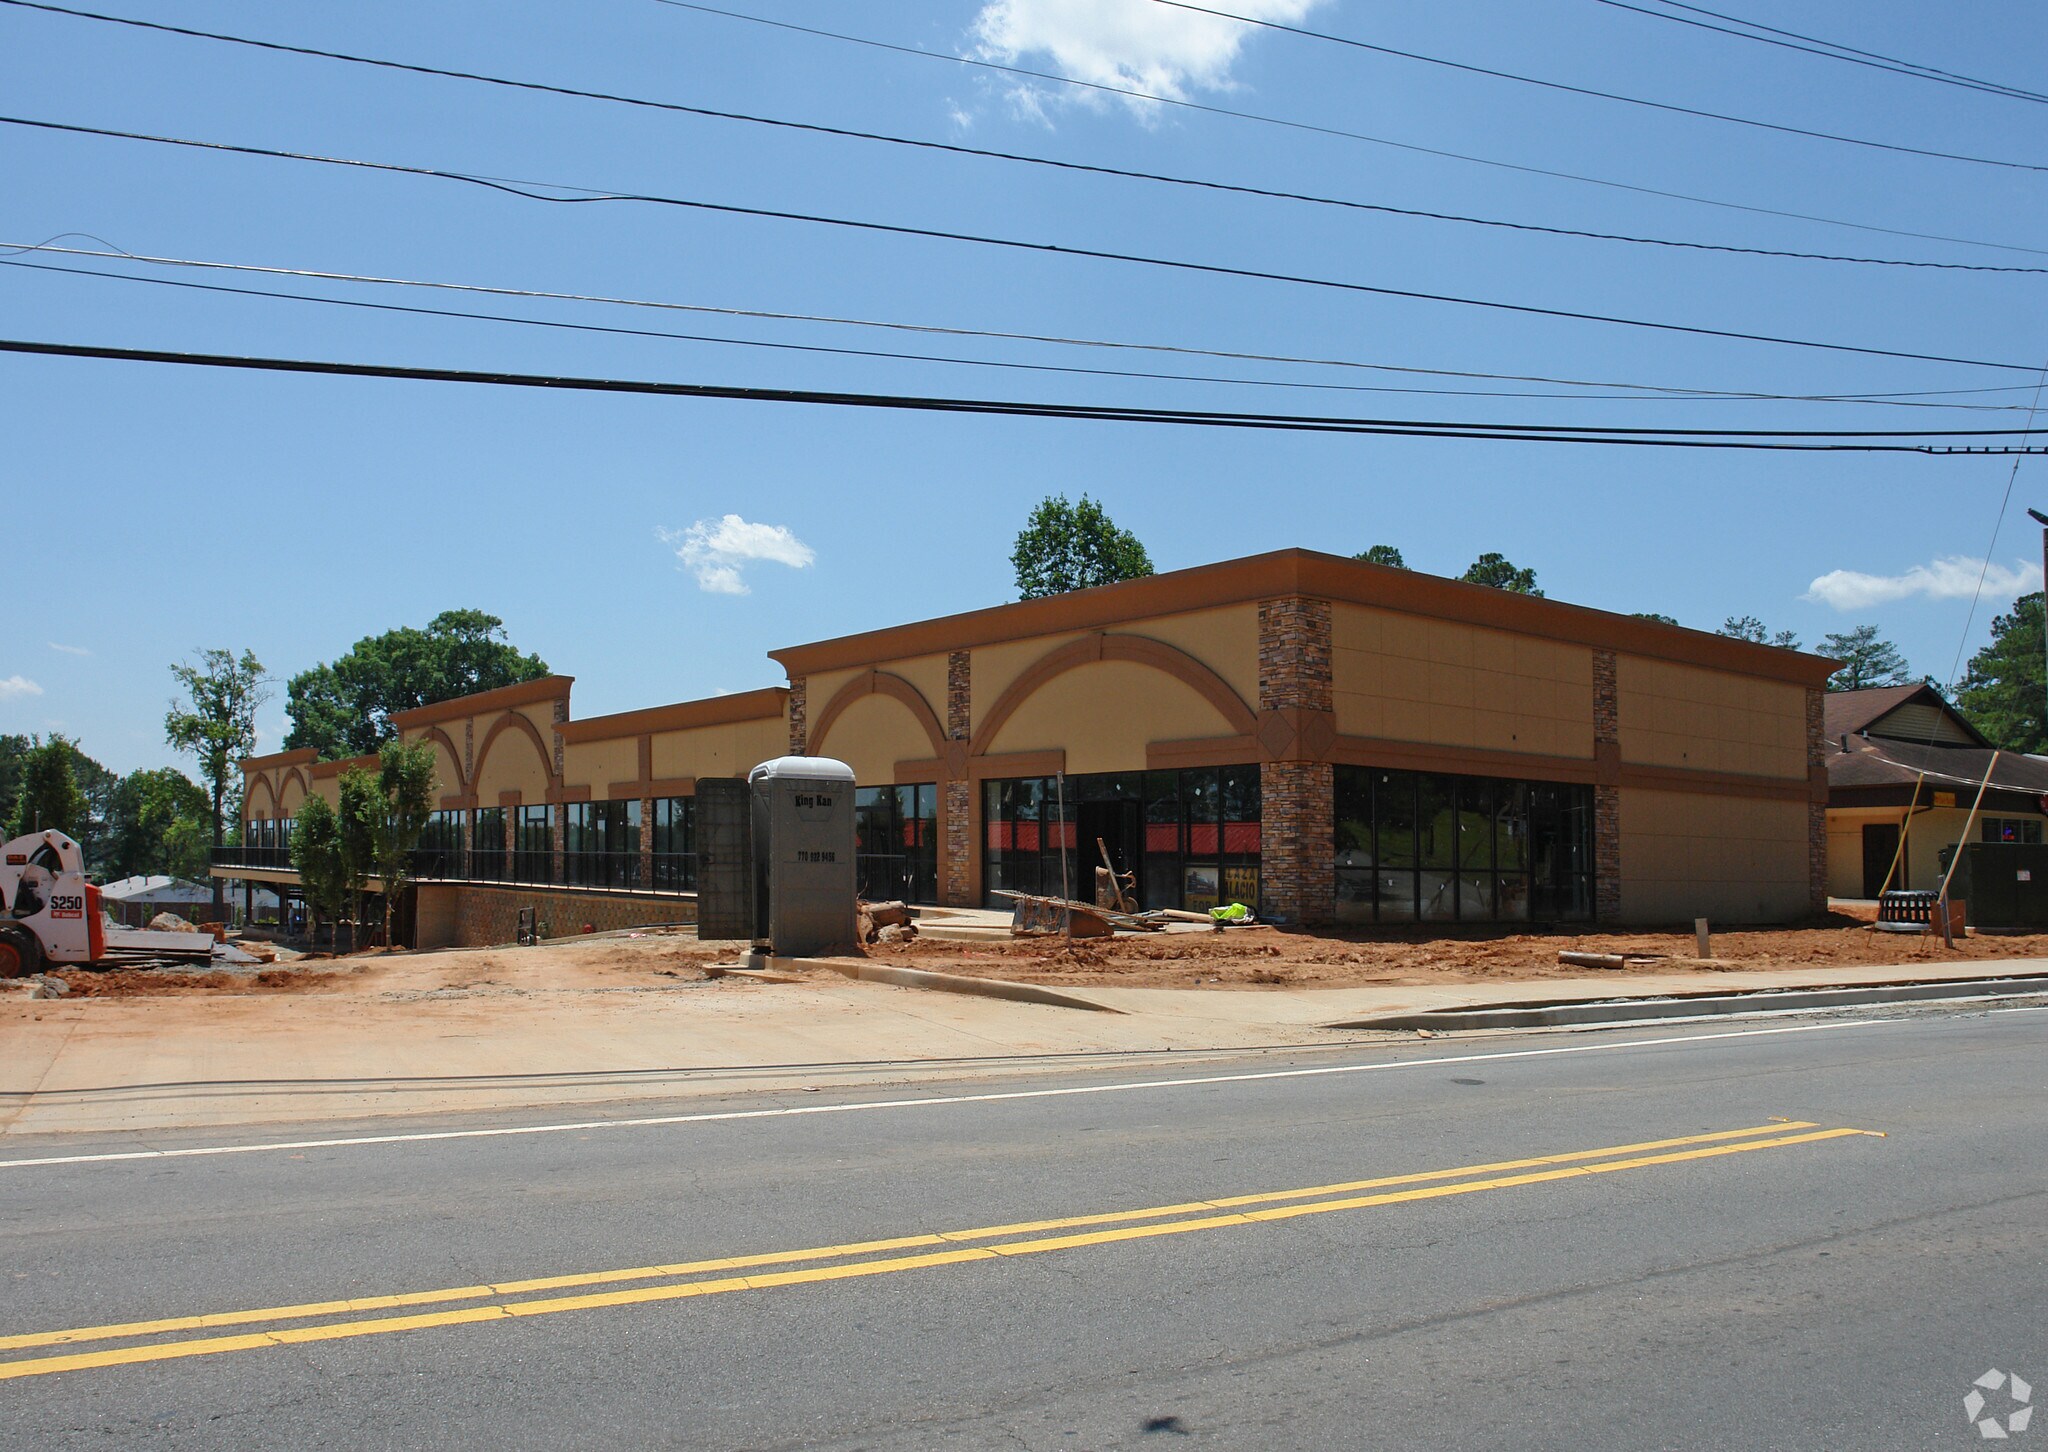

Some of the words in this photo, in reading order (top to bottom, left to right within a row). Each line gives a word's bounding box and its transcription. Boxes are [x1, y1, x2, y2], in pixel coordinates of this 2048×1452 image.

[795, 794, 814, 808] King
[816, 795, 832, 807] Kan
[798, 851, 809, 861] 770
[1225, 867, 1255, 879] LAZA
[51, 896, 82, 909] S250
